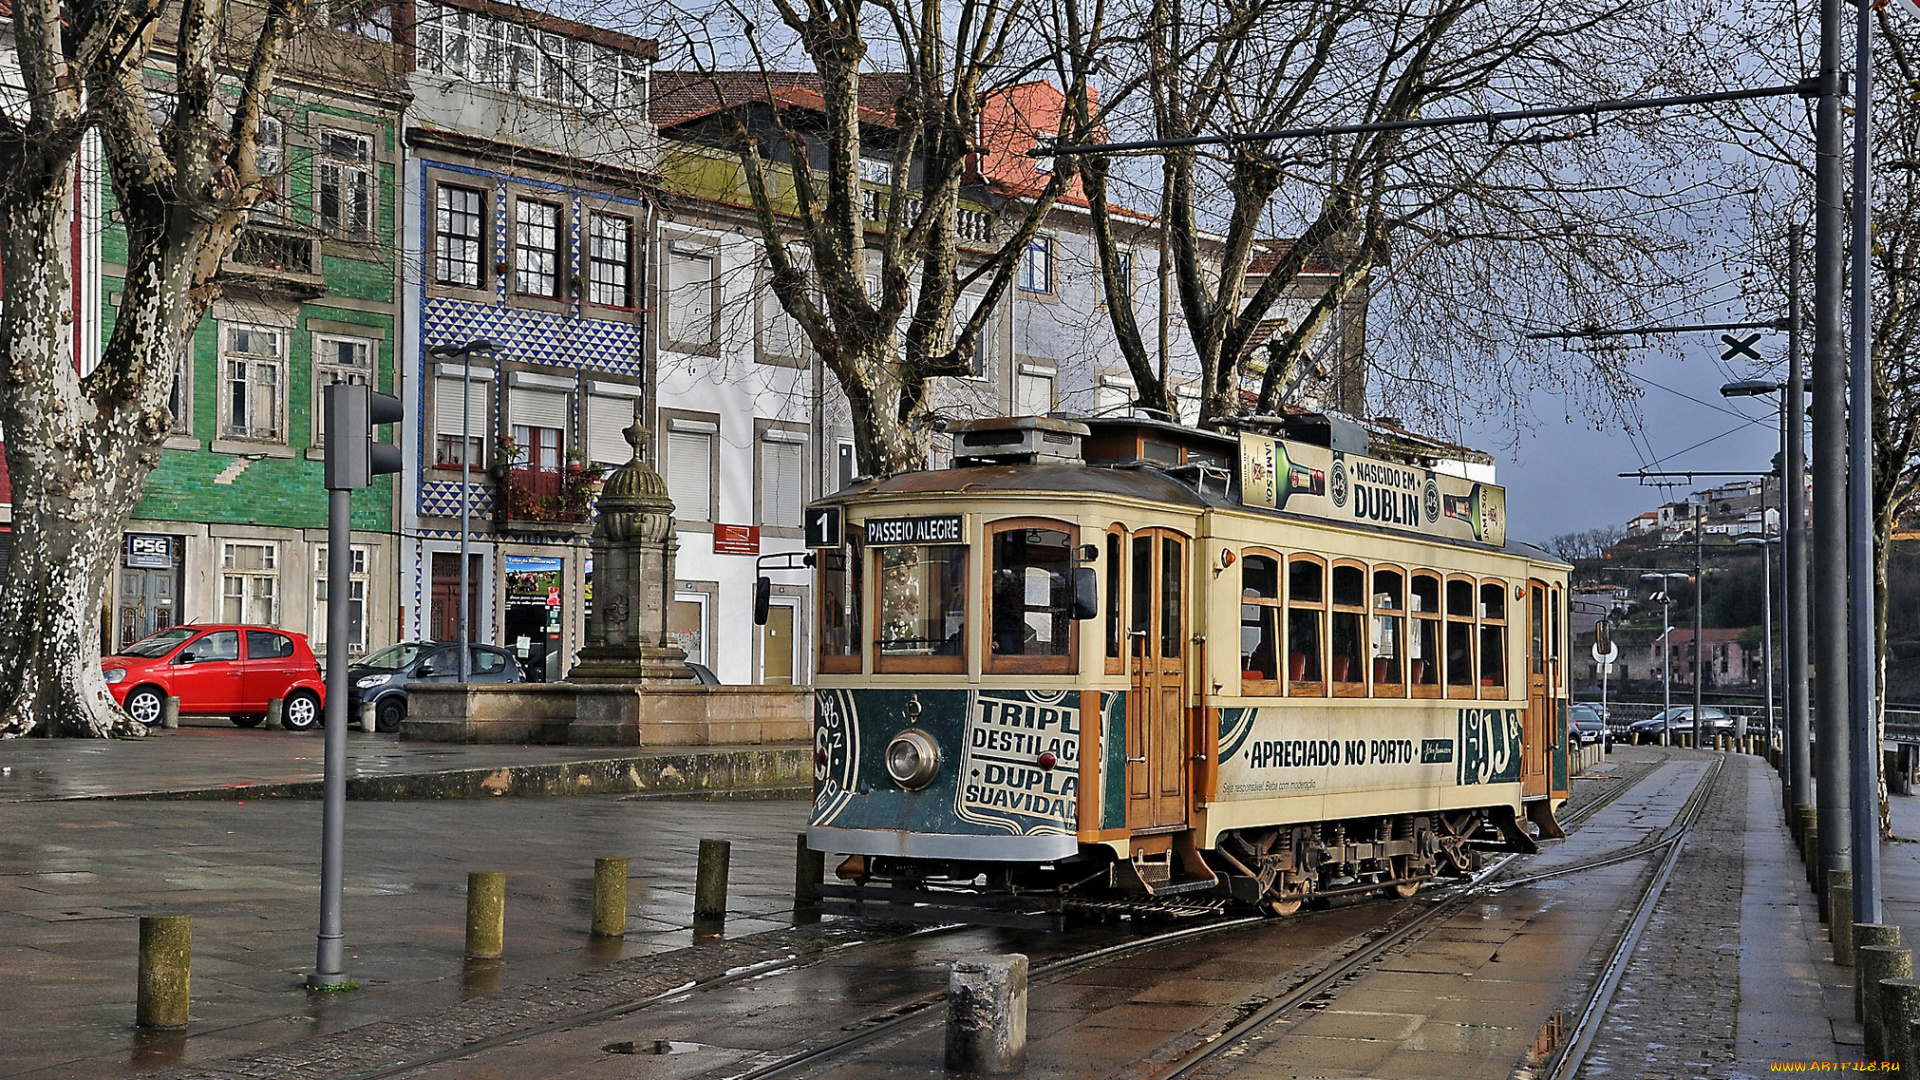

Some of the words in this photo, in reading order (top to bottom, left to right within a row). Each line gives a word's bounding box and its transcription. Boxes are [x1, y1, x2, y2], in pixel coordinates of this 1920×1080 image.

[1264, 442, 1273, 505] JAMESON
[1356, 461, 1400, 488] NASCIDO
[1402, 471, 1415, 491] EM
[1354, 483, 1419, 527] DUBLIN
[1481, 488, 1490, 540] JAMESON
[816, 512, 828, 543] 1
[868, 521, 914, 542] PASSEIO
[916, 519, 959, 540] ALEGRE
[133, 539, 166, 553] PSG
[978, 700, 1103, 737] TRIPL
[1250, 740, 1341, 768] APRECIADO
[1344, 740, 1366, 766] NO
[1370, 739, 1412, 764] PORTO
[984, 764, 1078, 798] DUPLA
